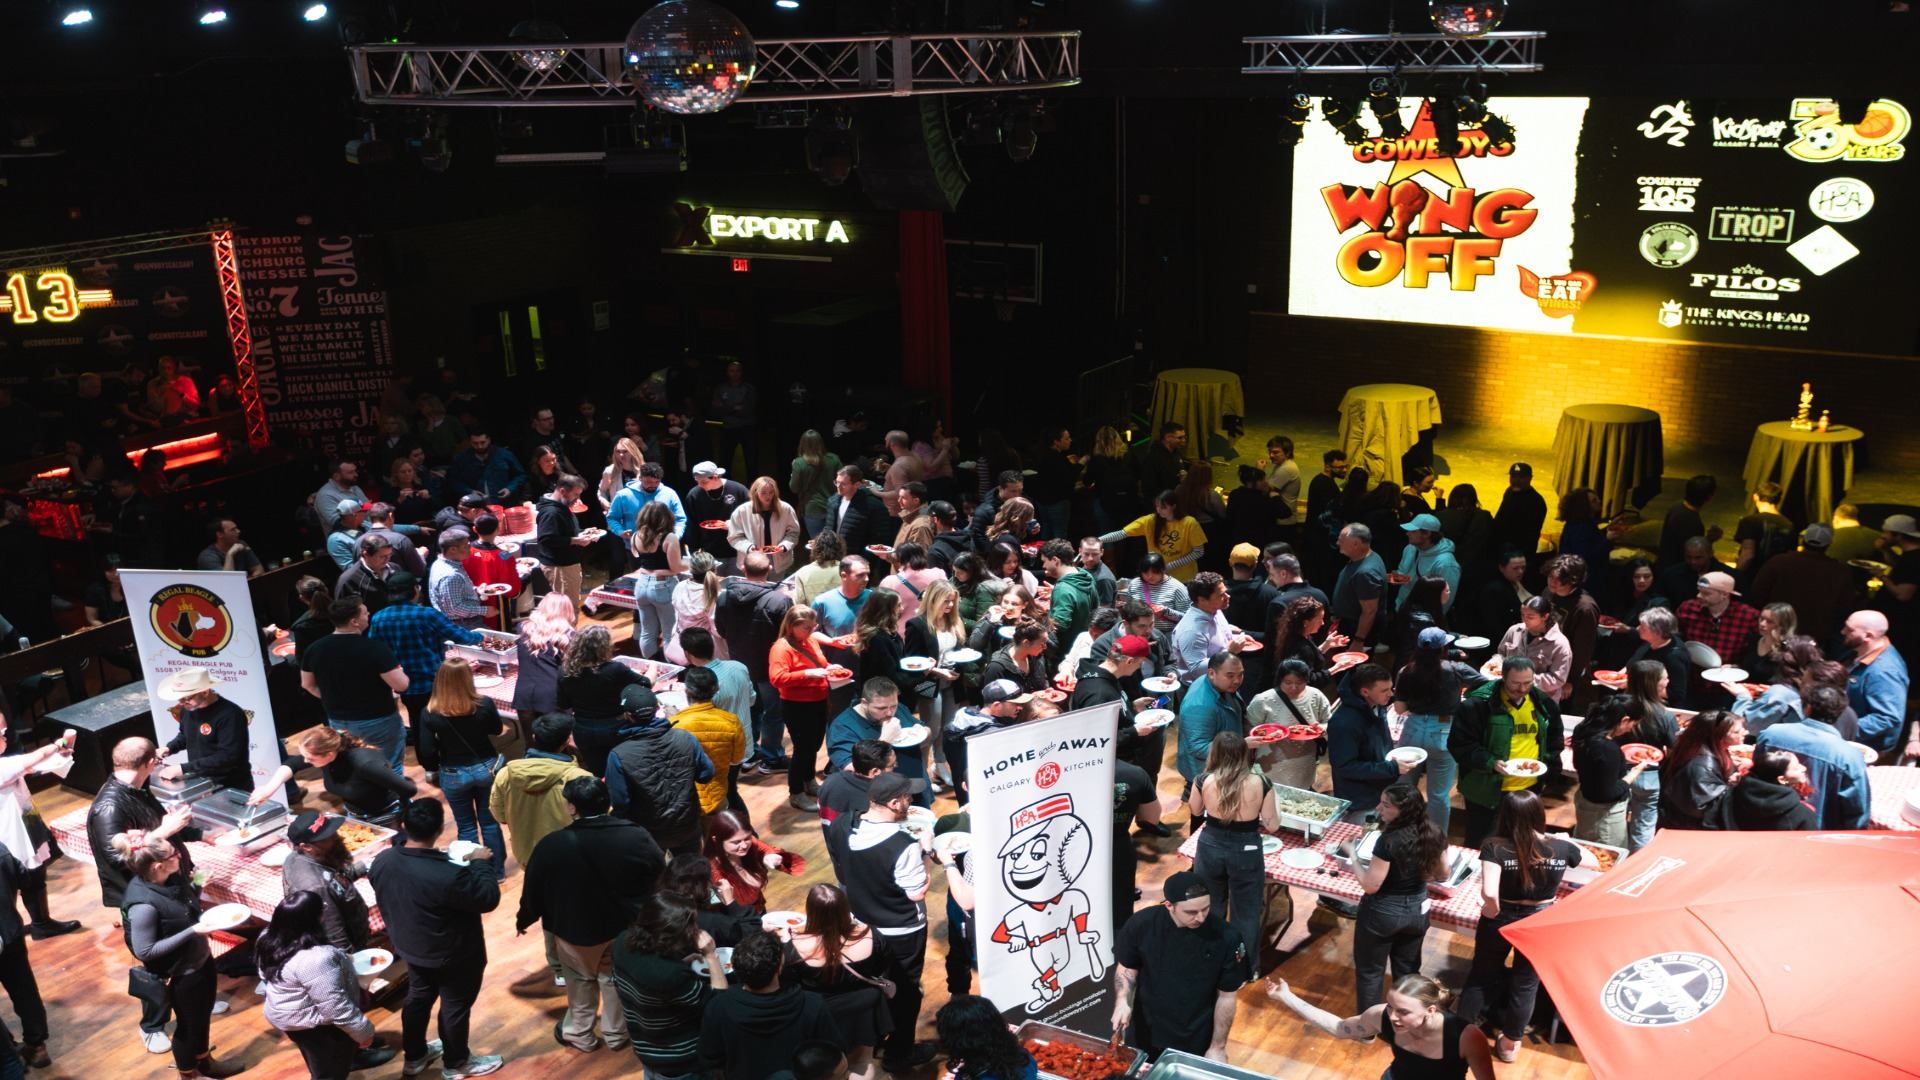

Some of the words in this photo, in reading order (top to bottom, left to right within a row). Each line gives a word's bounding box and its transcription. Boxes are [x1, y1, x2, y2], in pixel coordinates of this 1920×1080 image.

[1712, 117, 1788, 142] KidSport
[1845, 144, 1900, 159] YEARS
[1636, 176, 1702, 187] COUNTRY
[709, 214, 820, 242] EXPORT
[825, 220, 850, 243] A
[1719, 213, 1786, 237] TROP
[262, 234, 302, 246] DROP
[252, 246, 287, 256] ONLY
[238, 256, 305, 270] CHBURG
[1336, 231, 1504, 292] OFF
[1690, 273, 1801, 292] FILOS
[5, 273, 80, 324] 13
[1538, 284, 1582, 301] EAT
[268, 285, 300, 318] 7
[1685, 306, 1714, 318] THE
[1716, 308, 1763, 322] KINGS
[1765, 310, 1810, 324] HEAD
[333, 320, 360, 330] DAY
[302, 331, 344, 341] MAKE
[316, 341, 352, 351] MAKE
[287, 382, 315, 396] JACK
[316, 380, 356, 393] DANIEL
[158, 587, 184, 601] REGAL
[185, 587, 215, 602] BEAGLE
[192, 648, 206, 656] PUB
[209, 668, 237, 676] Calgary
[983, 749, 1036, 779] HOME
[1038, 741, 1057, 760] and
[1058, 737, 1111, 752] AWAY
[989, 777, 1032, 794] CALGARY
[1063, 757, 1104, 774] KITCHEN
